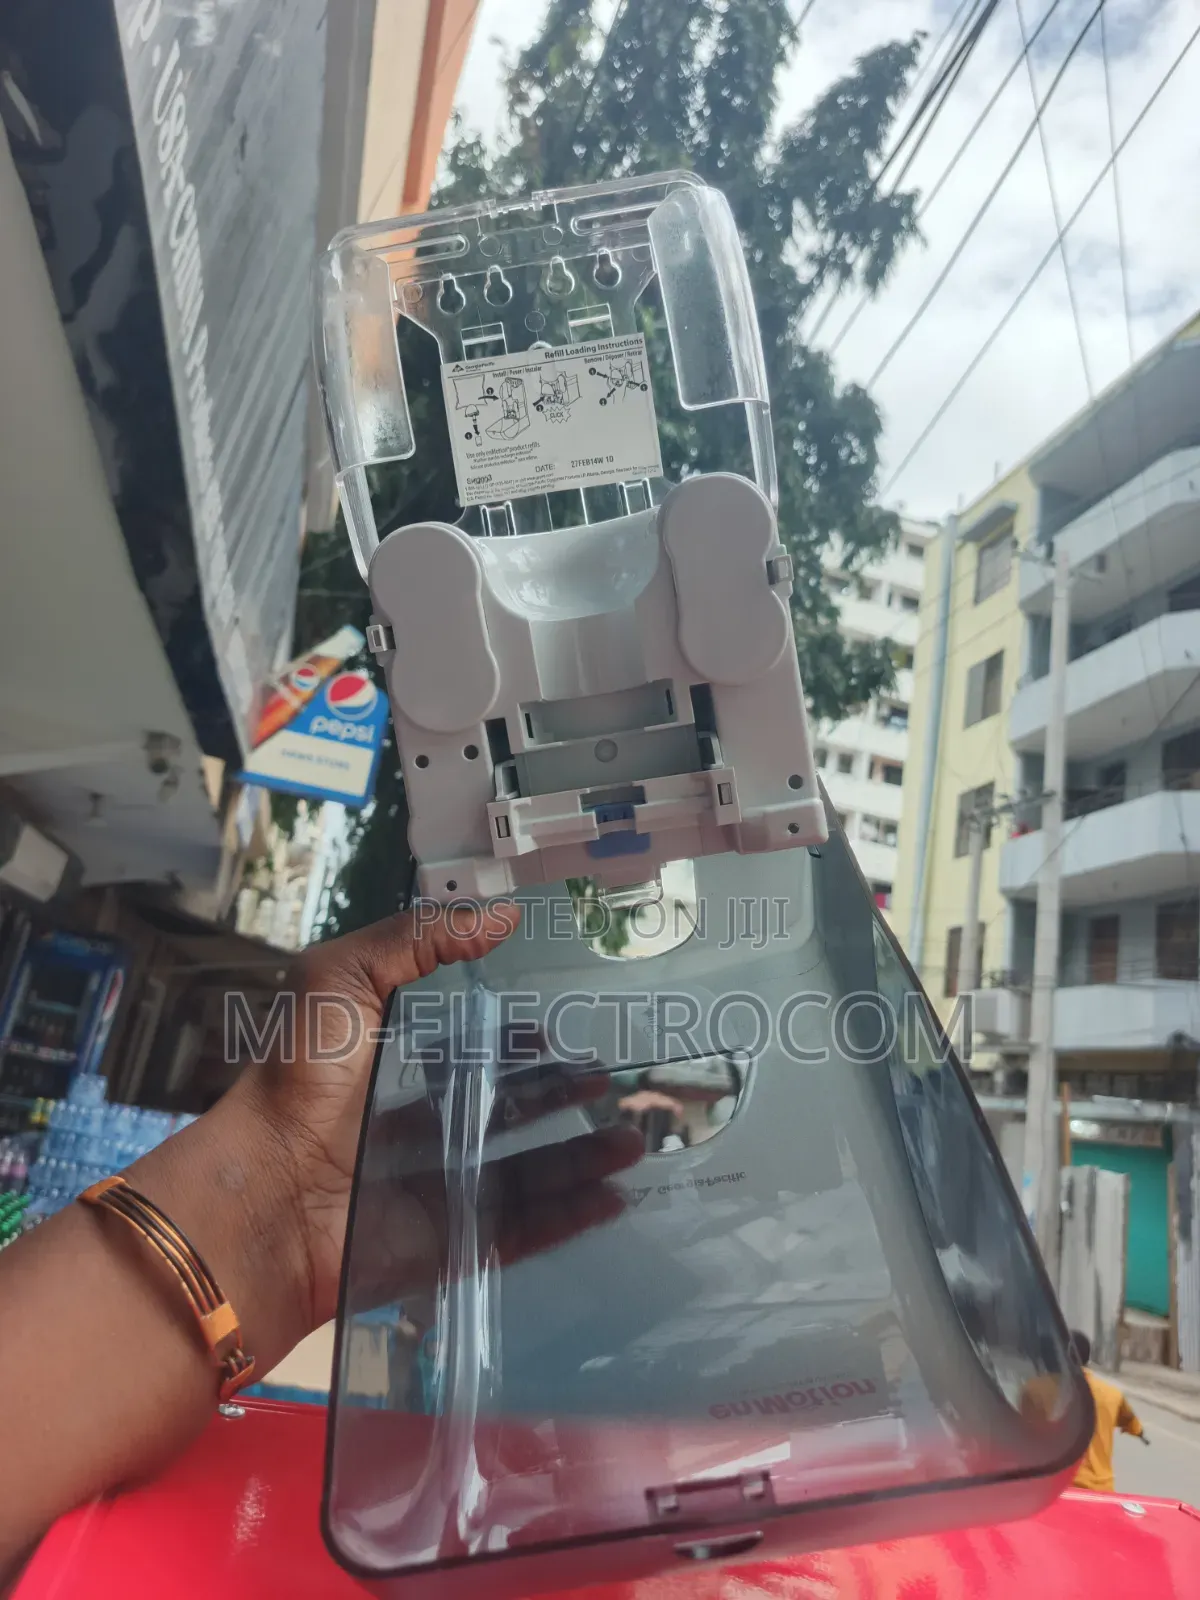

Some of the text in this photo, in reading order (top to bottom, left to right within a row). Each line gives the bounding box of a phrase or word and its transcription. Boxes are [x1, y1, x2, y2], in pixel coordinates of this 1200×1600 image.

[545, 337, 643, 359] Refill Loading Instructions
[535, 464, 556, 472] DATE:
[309, 715, 376, 743] pepsi
